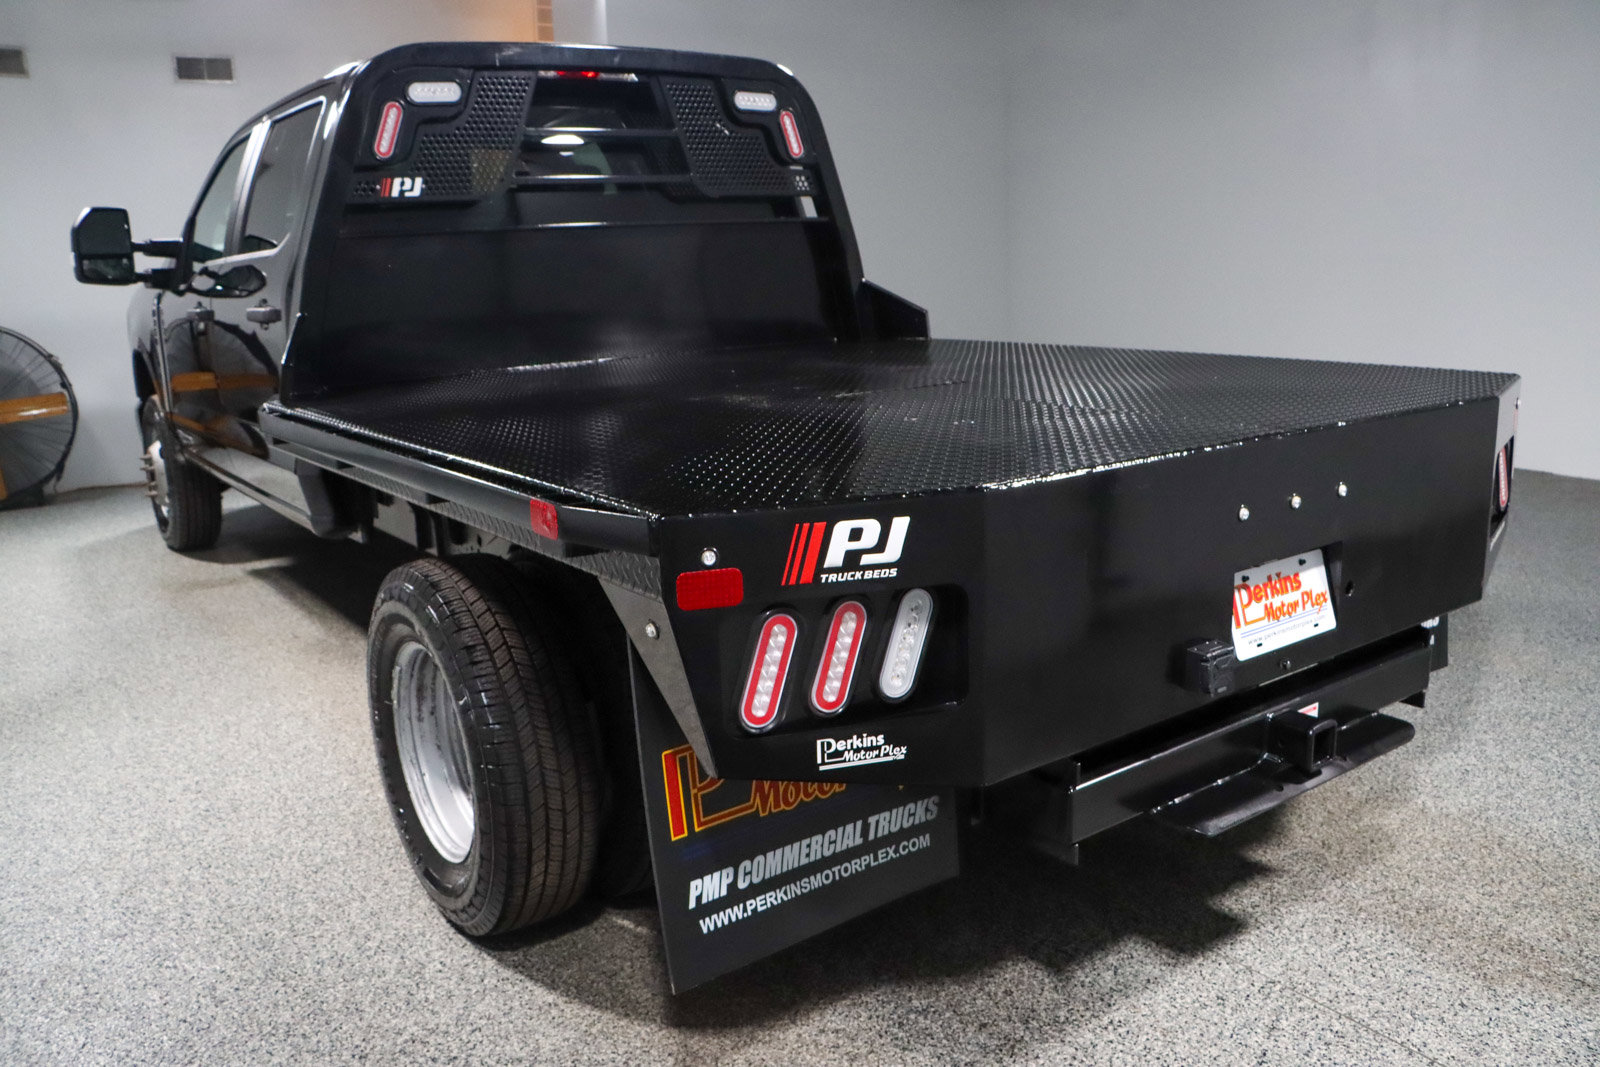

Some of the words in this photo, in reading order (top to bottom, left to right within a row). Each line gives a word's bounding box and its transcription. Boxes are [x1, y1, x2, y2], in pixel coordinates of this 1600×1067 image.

[391, 176, 423, 197] PJ
[823, 516, 911, 568] PJ
[1233, 572, 1302, 629] Perkins
[816, 733, 885, 764] Perkins
[688, 866, 735, 910] PMP
[737, 820, 864, 890] COMMERCIAL
[867, 795, 940, 841] TRUCKS
[699, 833, 931, 935] WWW.PERKINSMOTORPLEX.COM
